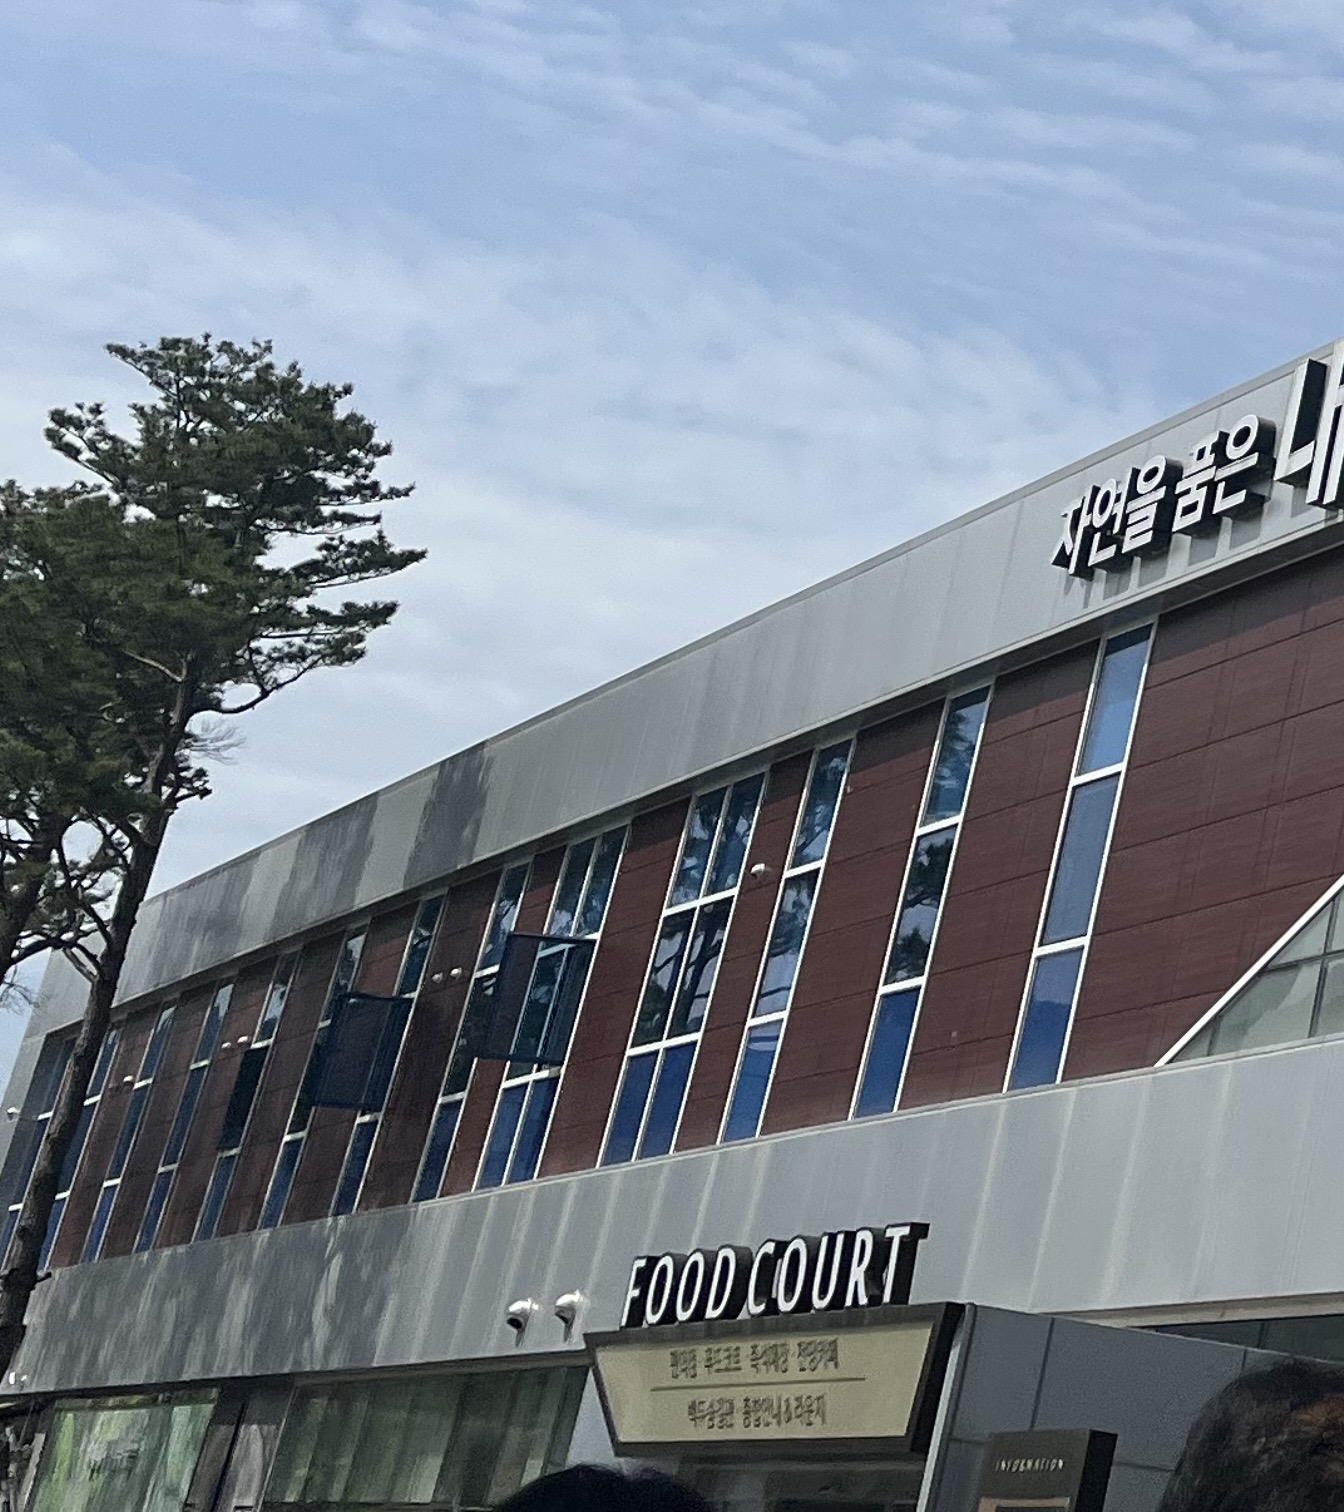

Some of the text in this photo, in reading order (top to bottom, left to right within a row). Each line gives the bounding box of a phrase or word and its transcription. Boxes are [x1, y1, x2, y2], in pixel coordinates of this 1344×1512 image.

[1051, 454, 1167, 575] 자연을
[1171, 413, 1260, 533] 품은
[620, 1225, 912, 1328] FOOD COURT
